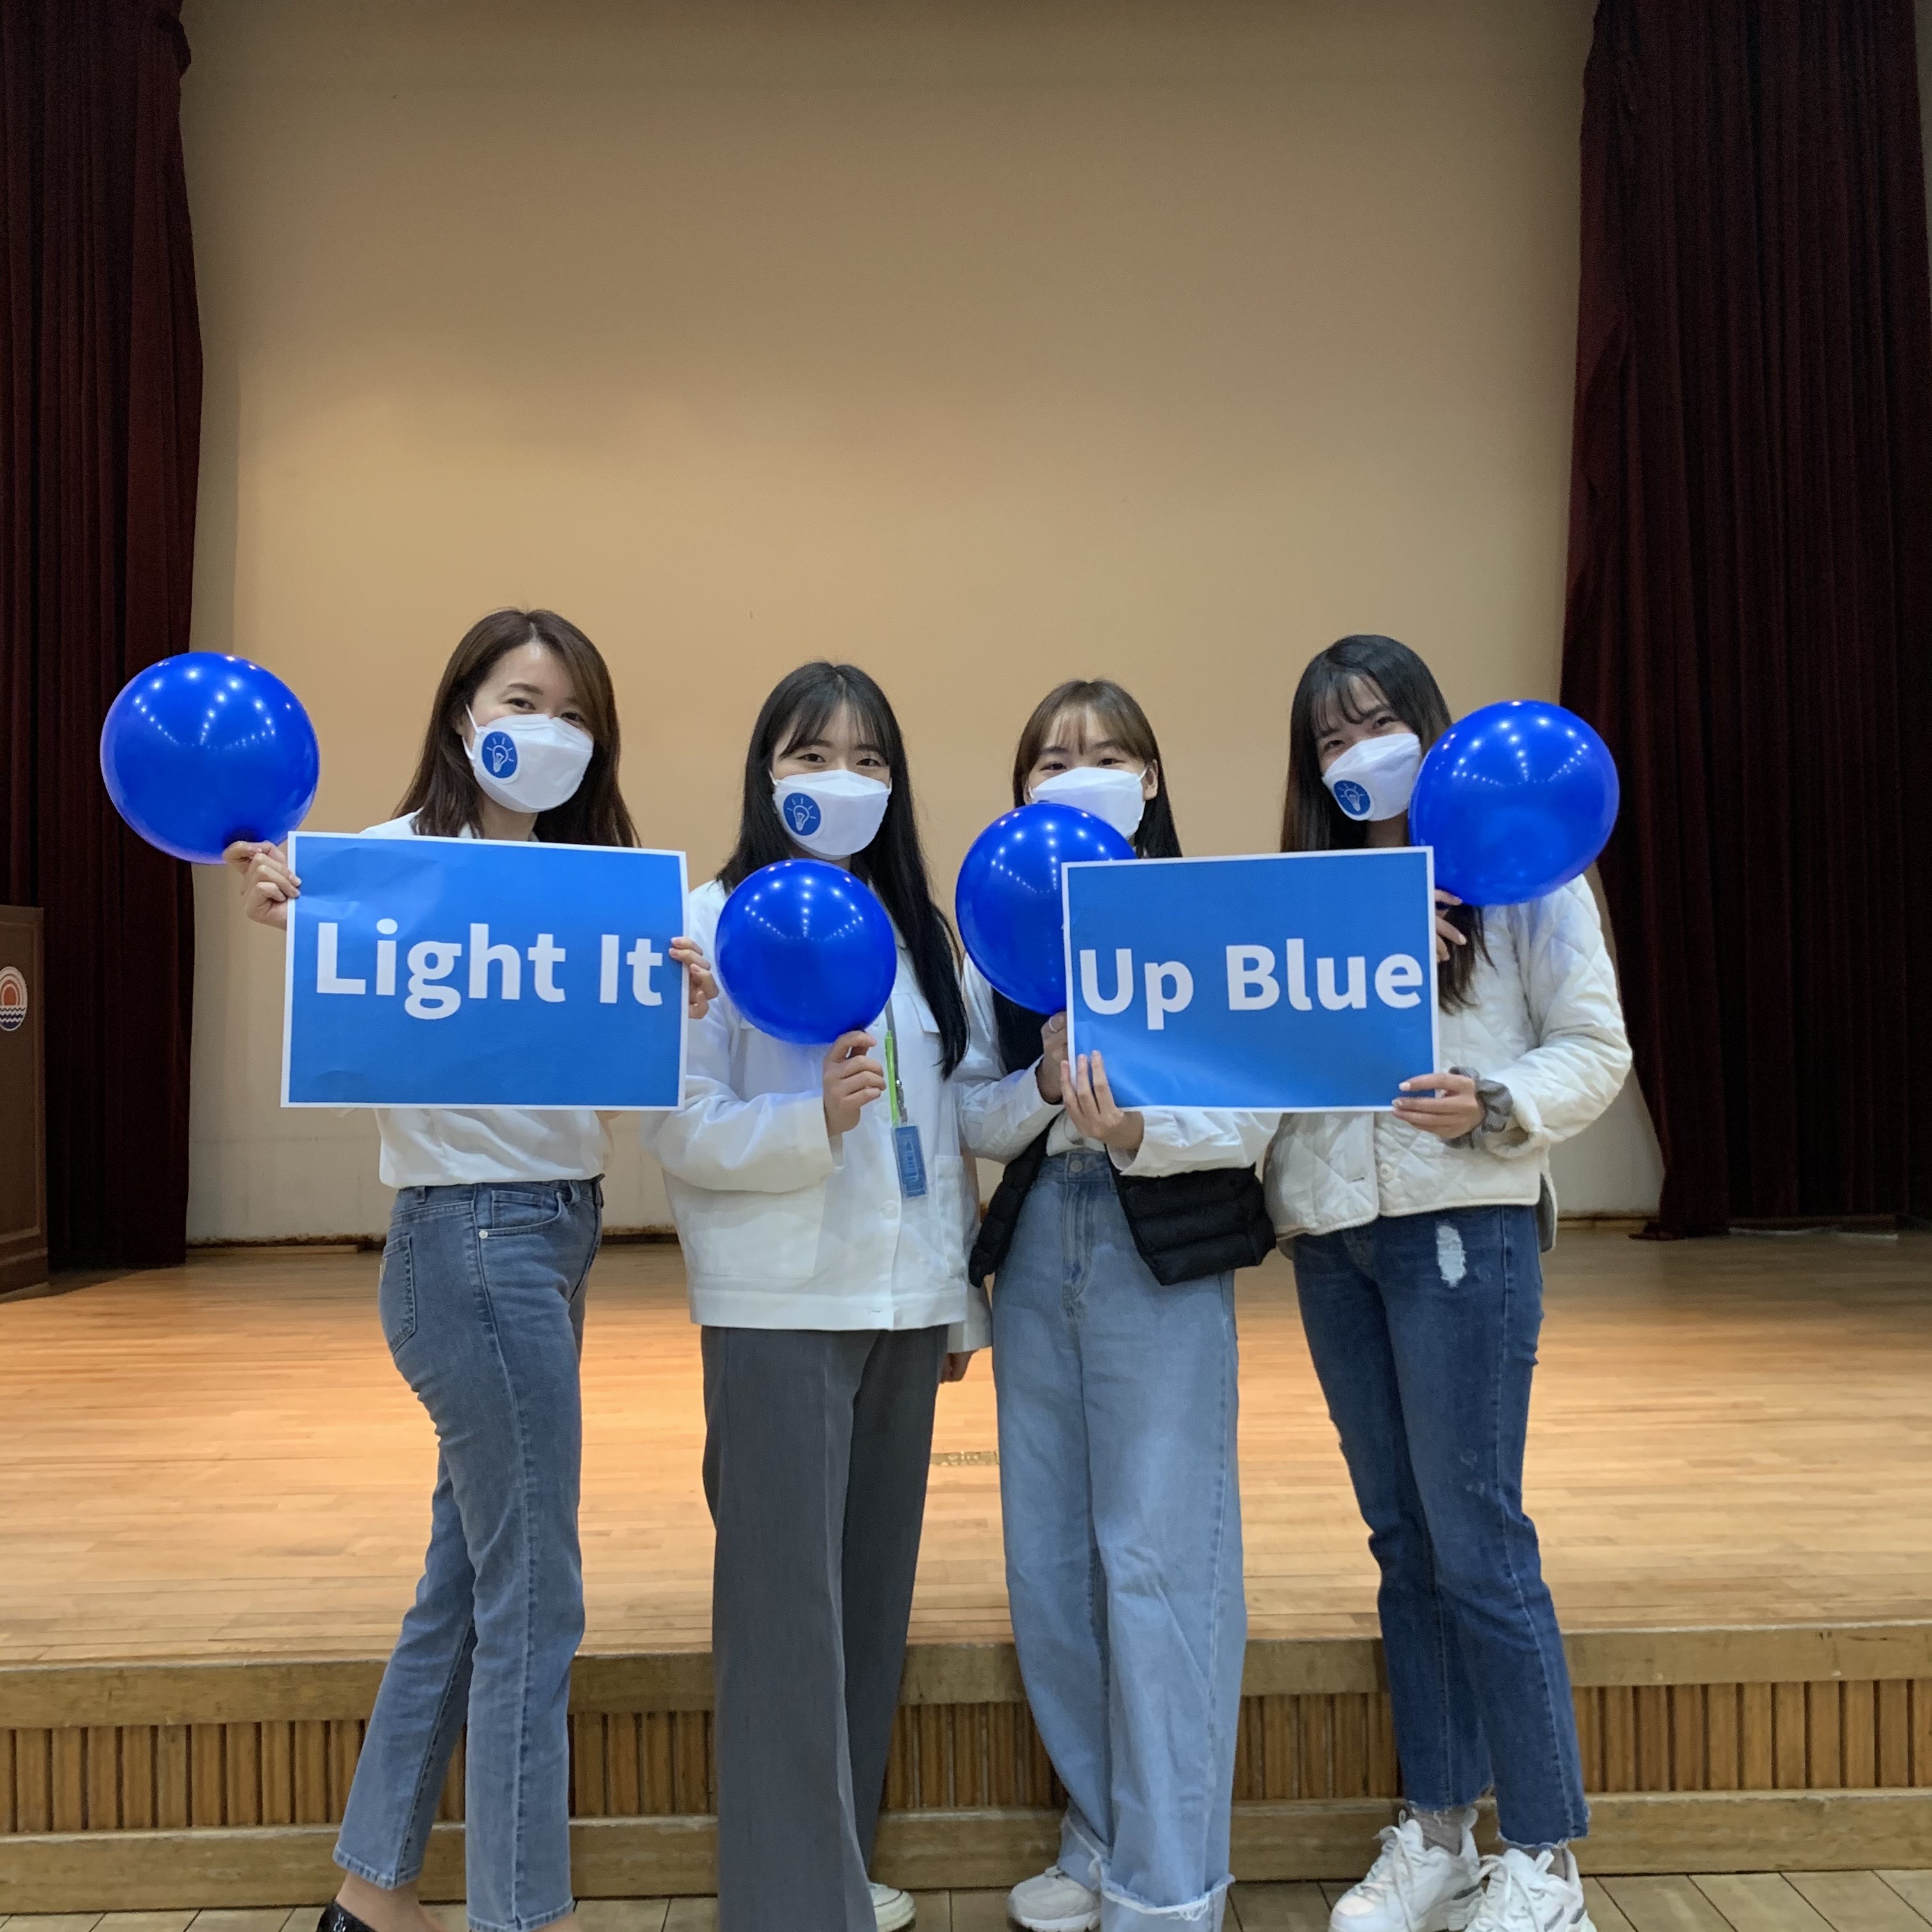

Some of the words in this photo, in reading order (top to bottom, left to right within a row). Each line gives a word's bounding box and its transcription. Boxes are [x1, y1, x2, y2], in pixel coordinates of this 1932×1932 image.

[316, 918, 566, 1020] Light
[599, 934, 663, 1006] It
[1079, 948, 1194, 1030] Up
[1225, 938, 1423, 1011] Blue
